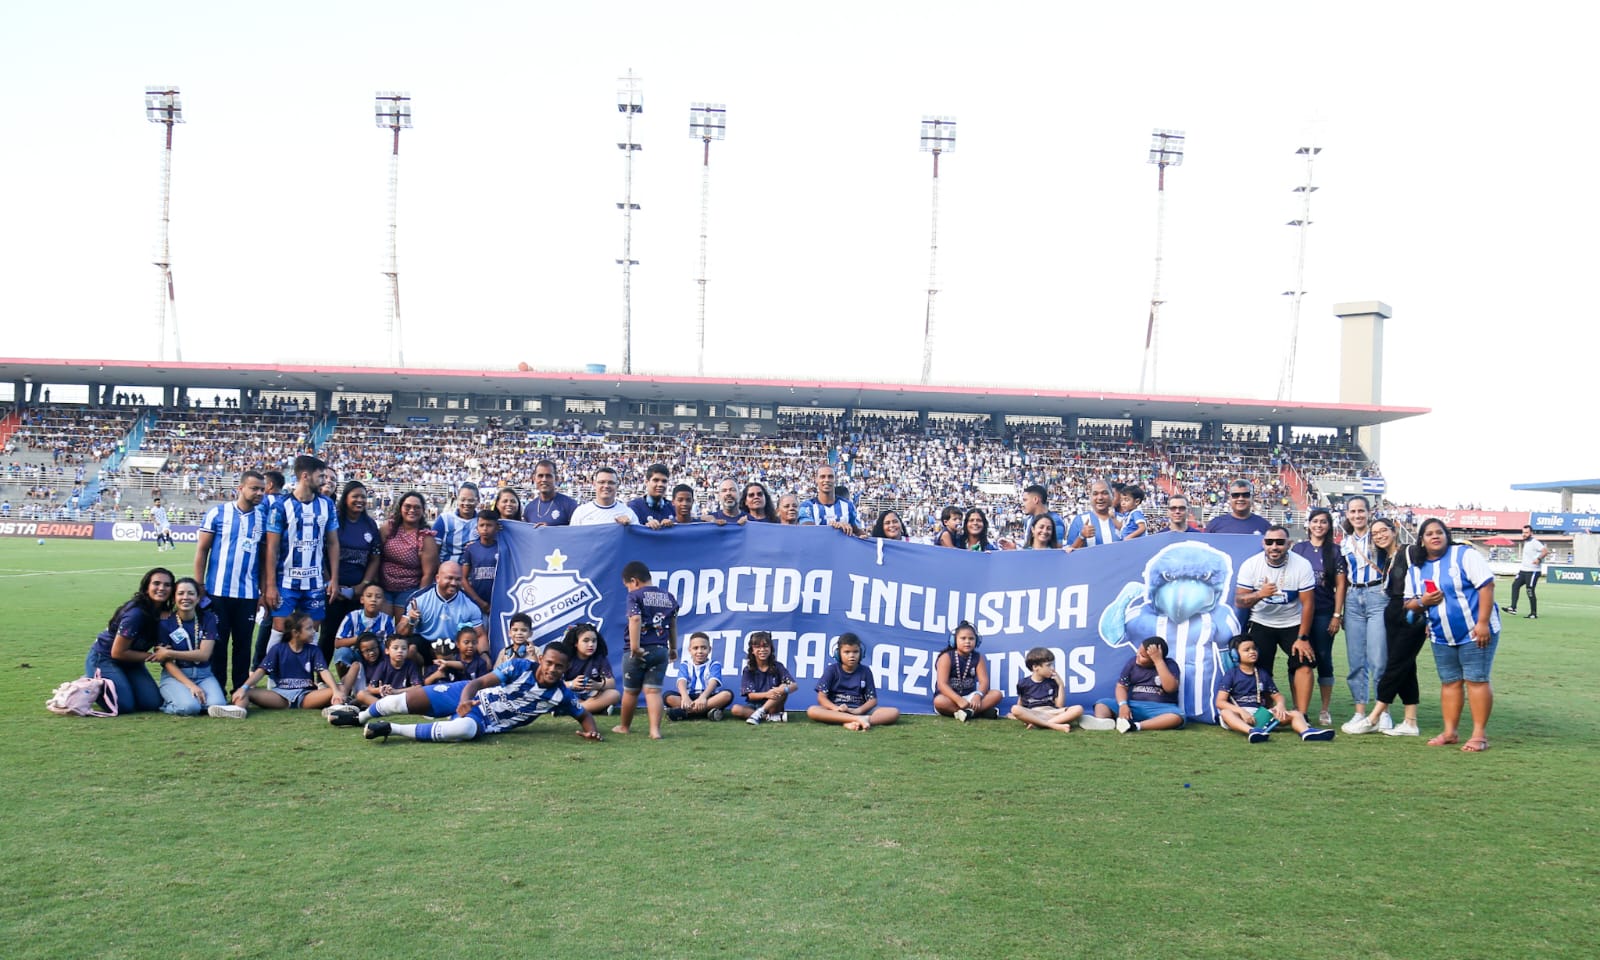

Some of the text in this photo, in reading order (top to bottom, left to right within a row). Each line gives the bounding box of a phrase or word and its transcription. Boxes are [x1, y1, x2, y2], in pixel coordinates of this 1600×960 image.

[596, 419, 645, 429] REI
[658, 421, 730, 433] PELÉ
[1536, 515, 1564, 526] smile
[0, 522, 94, 537] STA GANHA
[115, 525, 140, 538] bet
[845, 572, 1089, 635] INCLUSIVA
